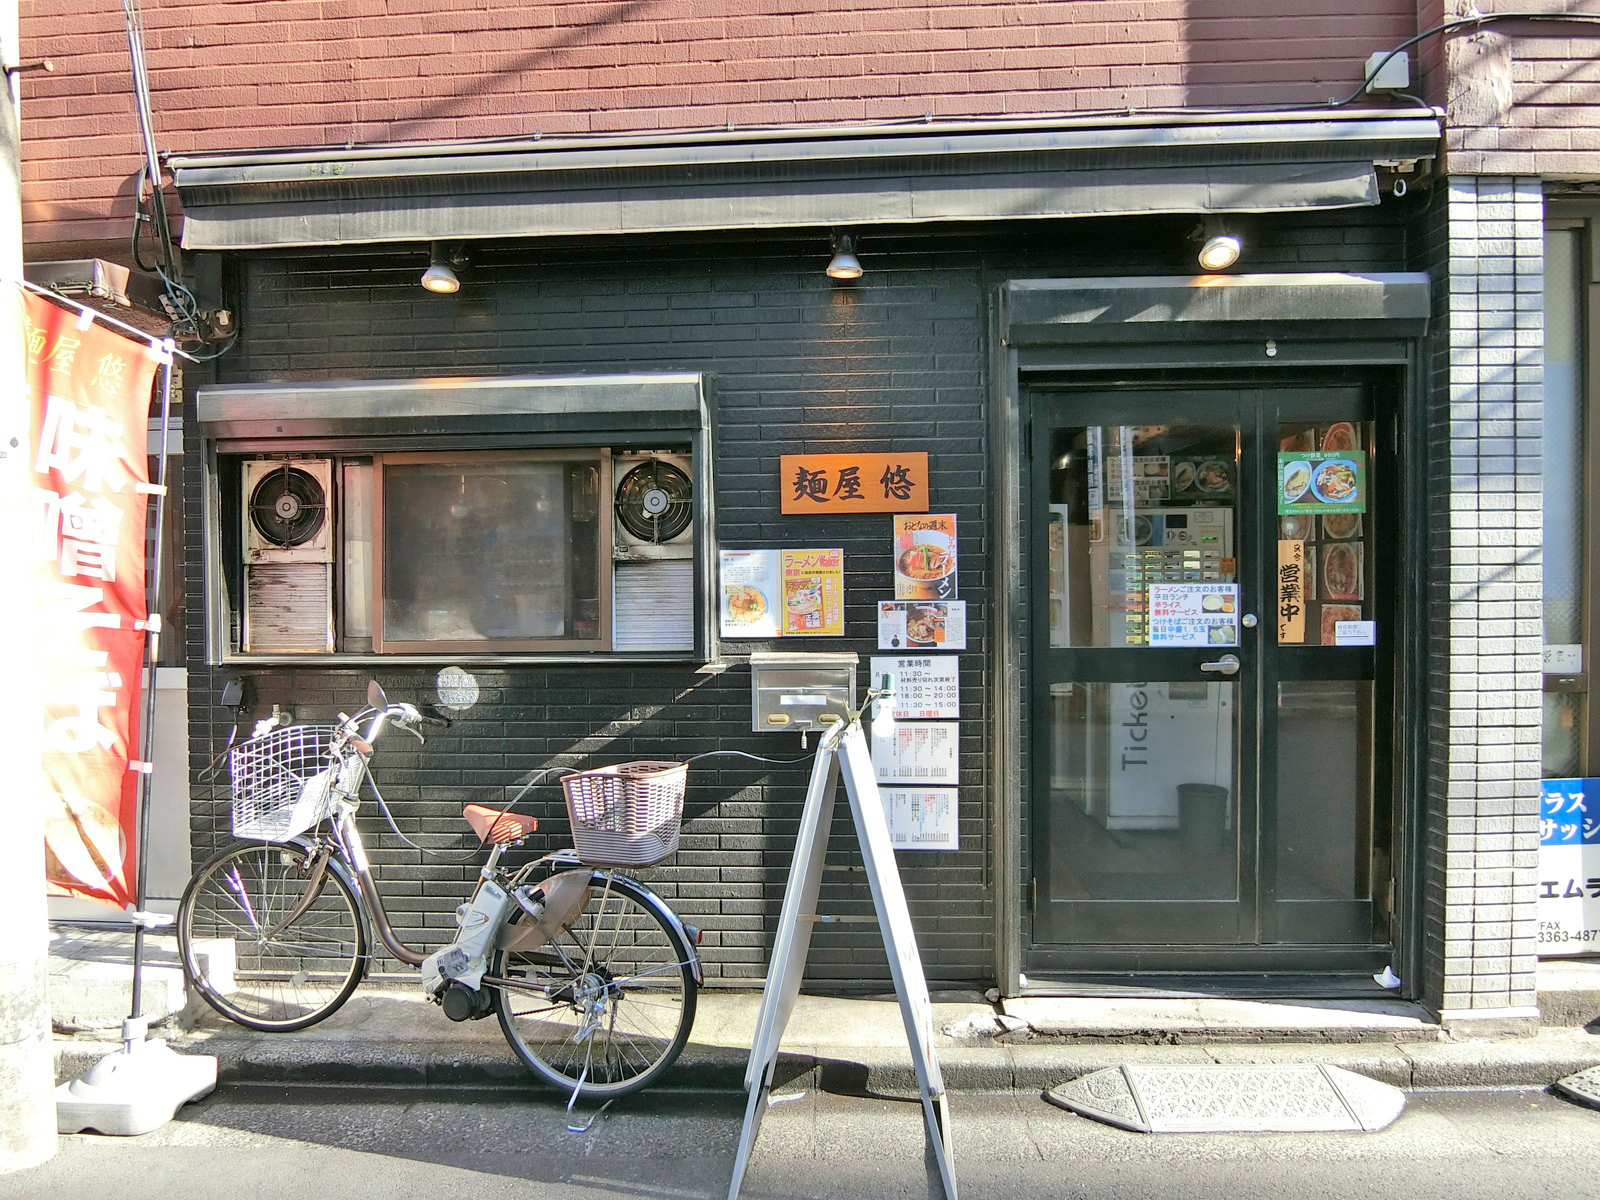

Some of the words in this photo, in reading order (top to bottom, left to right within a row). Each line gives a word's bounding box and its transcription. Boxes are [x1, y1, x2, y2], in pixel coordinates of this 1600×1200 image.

[903, 520, 948, 531] おとなの週末
[938, 551, 952, 599] ラーメン
[1154, 585, 1232, 593] ラーメンご注文のお客様
[1280, 563, 1301, 622] 営業中
[897, 659, 931, 668] 営業時間
[1539, 791, 1588, 814] ラス
[1537, 930, 1600, 942] 3363-487
